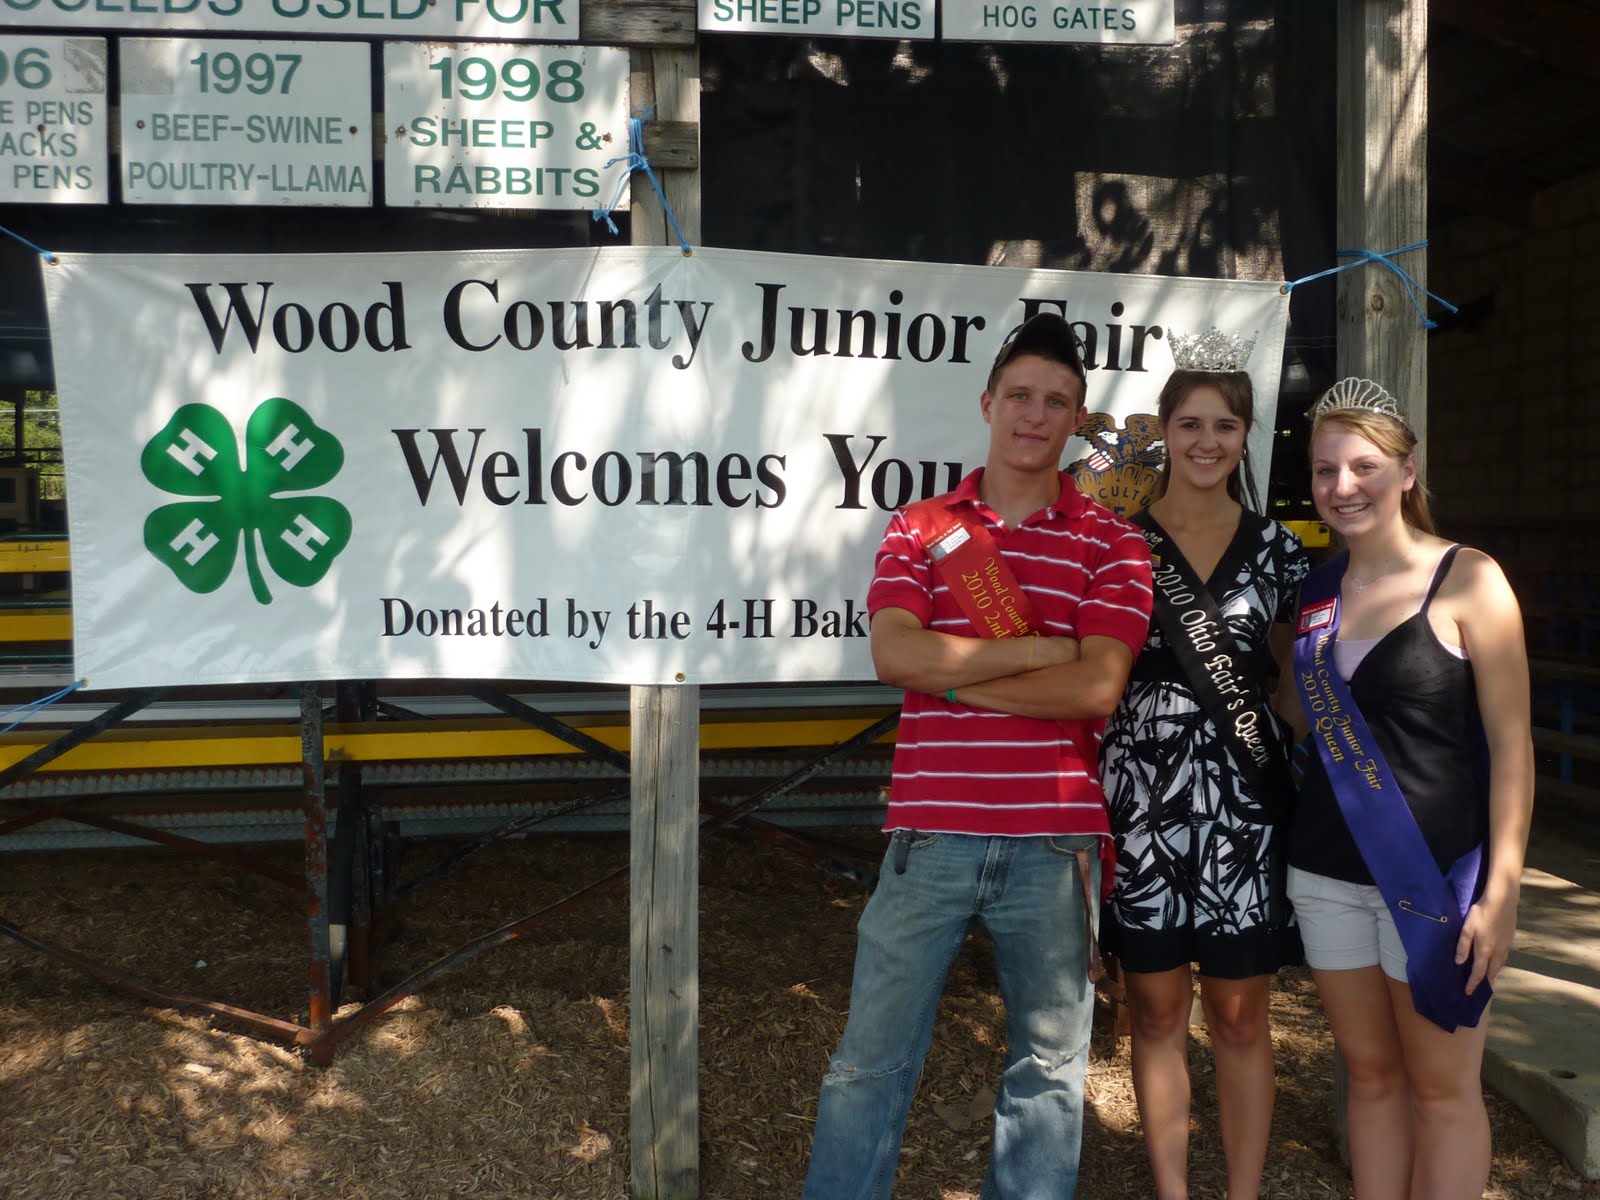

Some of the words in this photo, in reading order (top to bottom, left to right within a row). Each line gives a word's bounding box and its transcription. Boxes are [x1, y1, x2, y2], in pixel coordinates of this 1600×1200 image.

[713, 0, 821, 25] SHEEP
[836, 0, 921, 30] PENS
[983, 5, 1037, 28] HOG
[1053, 7, 1137, 32] GATES
[0, 47, 52, 90] 6
[190, 52, 303, 95] 1997
[429, 56, 585, 103] 1998
[27, 101, 93, 126] PENS
[151, 113, 343, 144] BEEF-SWINE
[409, 116, 554, 150] SHEEP
[575, 121, 602, 151] &
[0, 132, 77, 158] ACKS
[14, 165, 92, 190] PENS
[128, 161, 368, 194] POULTRY-LLAMA
[414, 165, 600, 197] RABBITS
[185, 281, 412, 354] Wood
[443, 279, 714, 370] County
[742, 283, 986, 364] Junior
[391, 428, 787, 510] Welcomes
[823, 433, 963, 512] You
[962, 570, 993, 609] 2010
[984, 611, 1010, 639] 2nd
[984, 557, 1009, 596] Wood
[1000, 595, 1030, 636] County
[380, 597, 550, 639] Donated
[567, 598, 612, 650] by
[627, 599, 691, 640] the
[706, 598, 777, 639] 4-H
[1152, 564, 1195, 606] 2010
[1180, 609, 1220, 652] Ohio
[1204, 654, 1250, 711] Fair's
[1234, 711, 1272, 768] Queen
[1314, 627, 1333, 667] Wood
[1317, 669, 1342, 714] County
[1301, 671, 1326, 712] 2010
[1315, 716, 1345, 763] Queen
[1333, 715, 1364, 756] Junior
[1355, 758, 1382, 791] Fair
